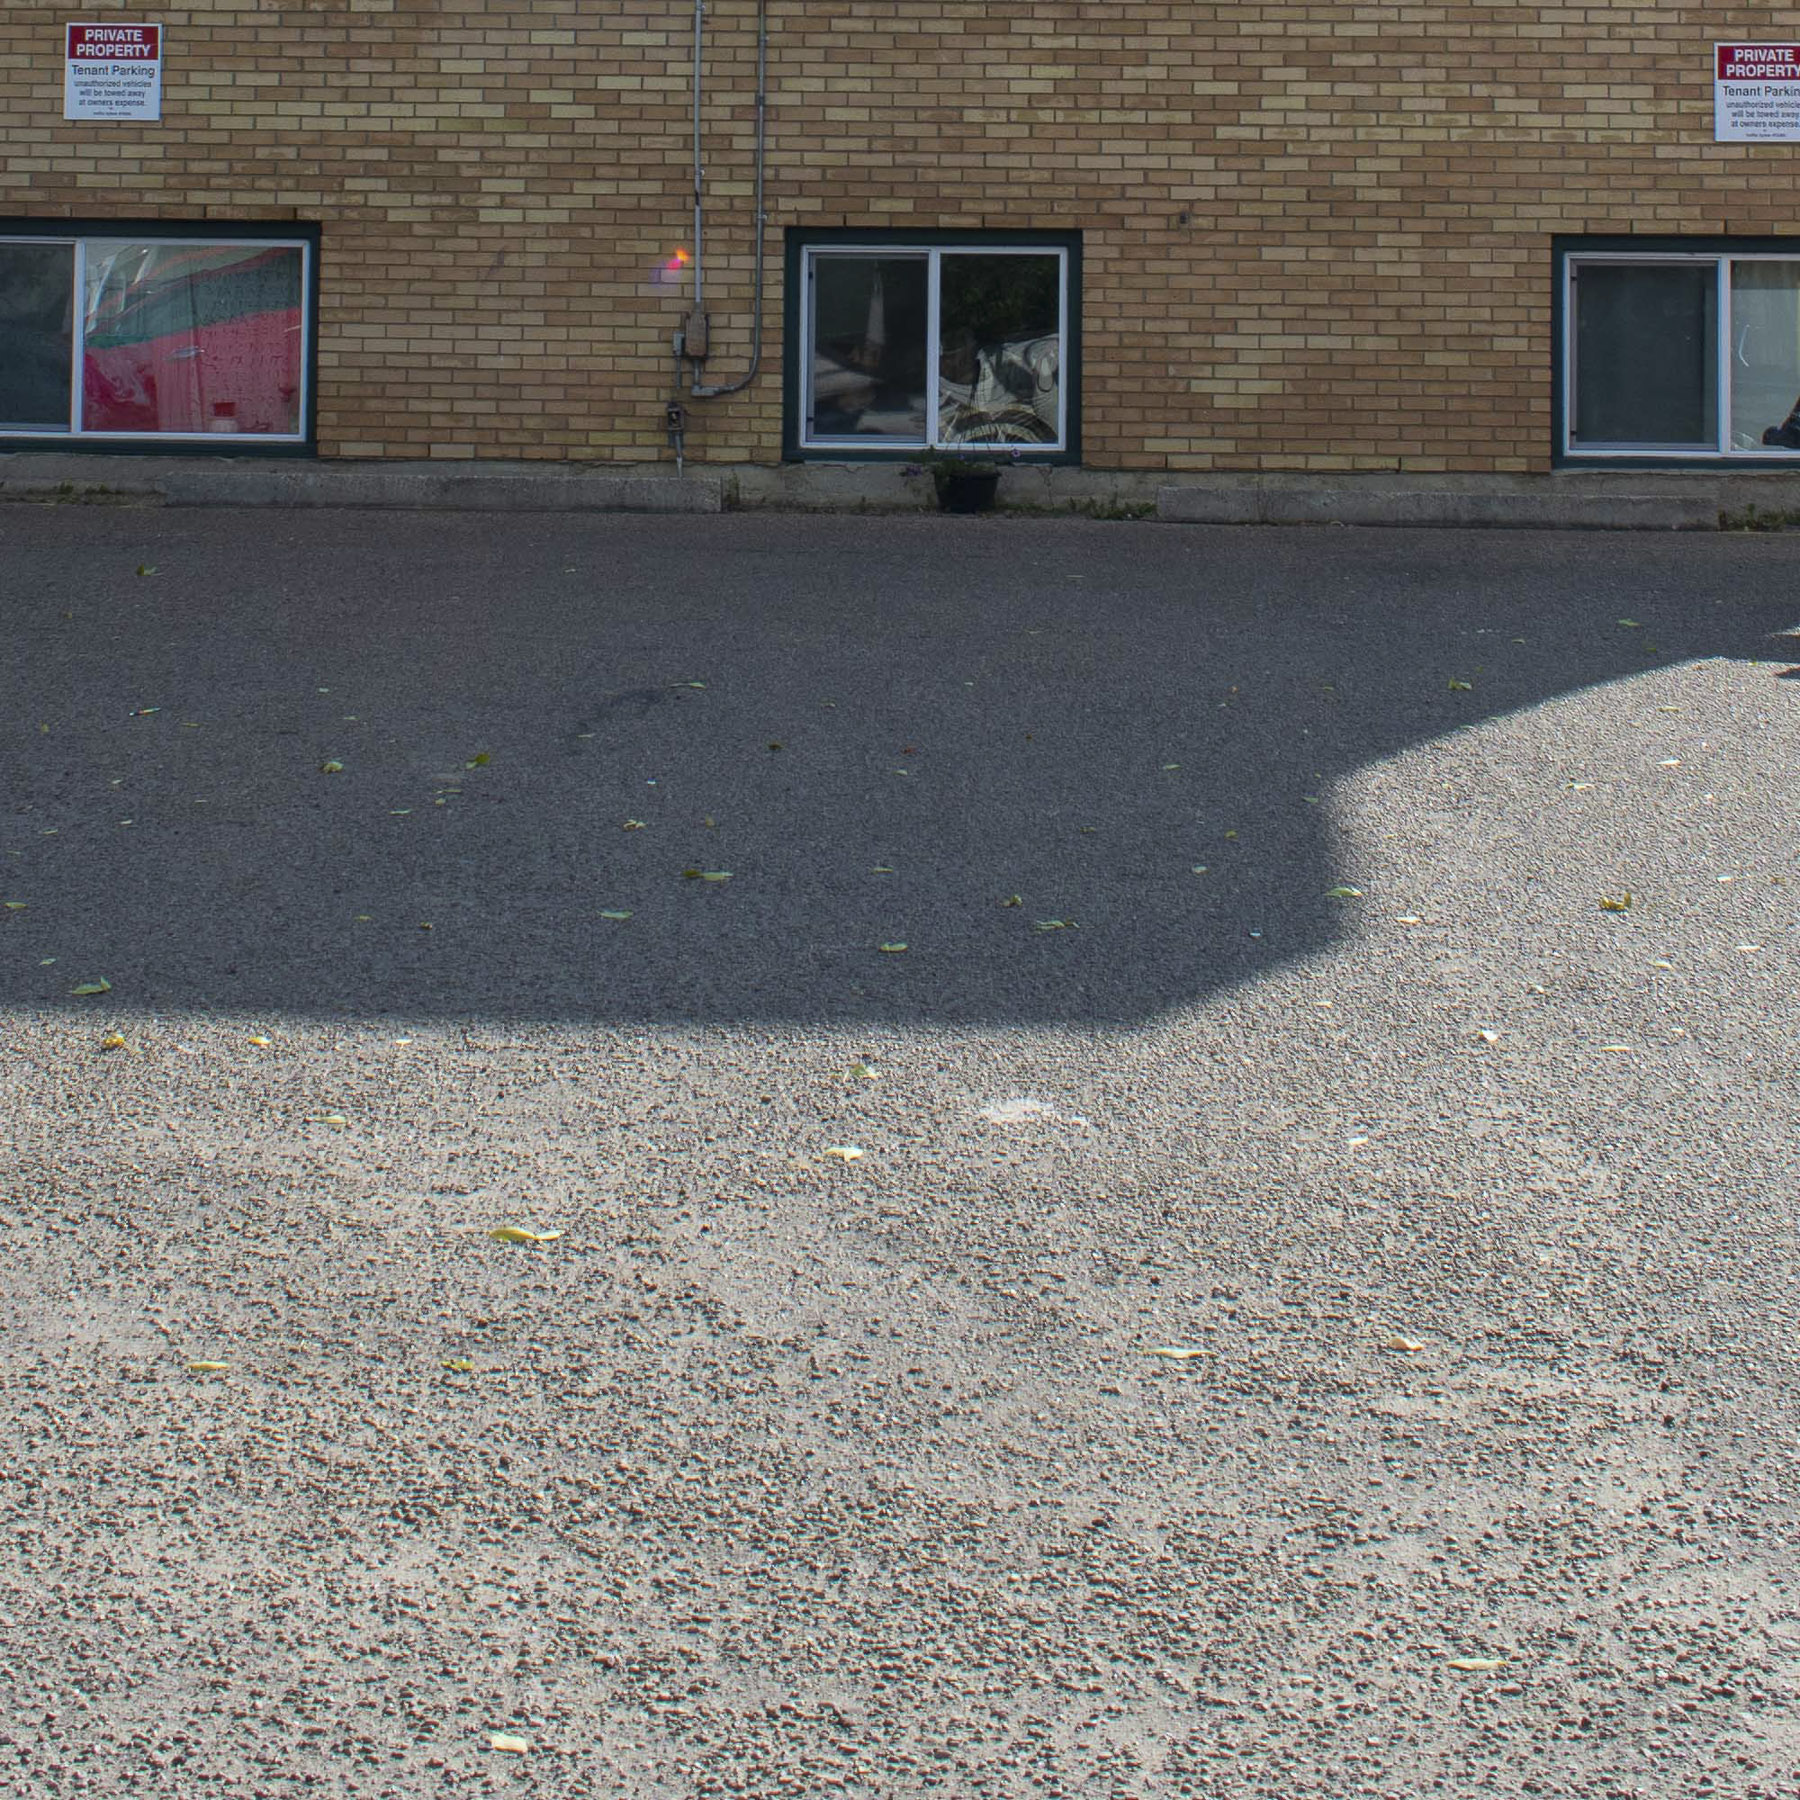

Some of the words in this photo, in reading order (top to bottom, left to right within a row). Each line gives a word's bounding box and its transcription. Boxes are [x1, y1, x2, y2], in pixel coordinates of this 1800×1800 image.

[85, 29, 143, 42] PRIVATE
[76, 43, 151, 57] PROPERTY
[1734, 49, 1794, 62] PRIVATE
[71, 64, 109, 76] Tenant
[112, 64, 156, 78] Parking
[1723, 85, 1761, 97] Tenant
